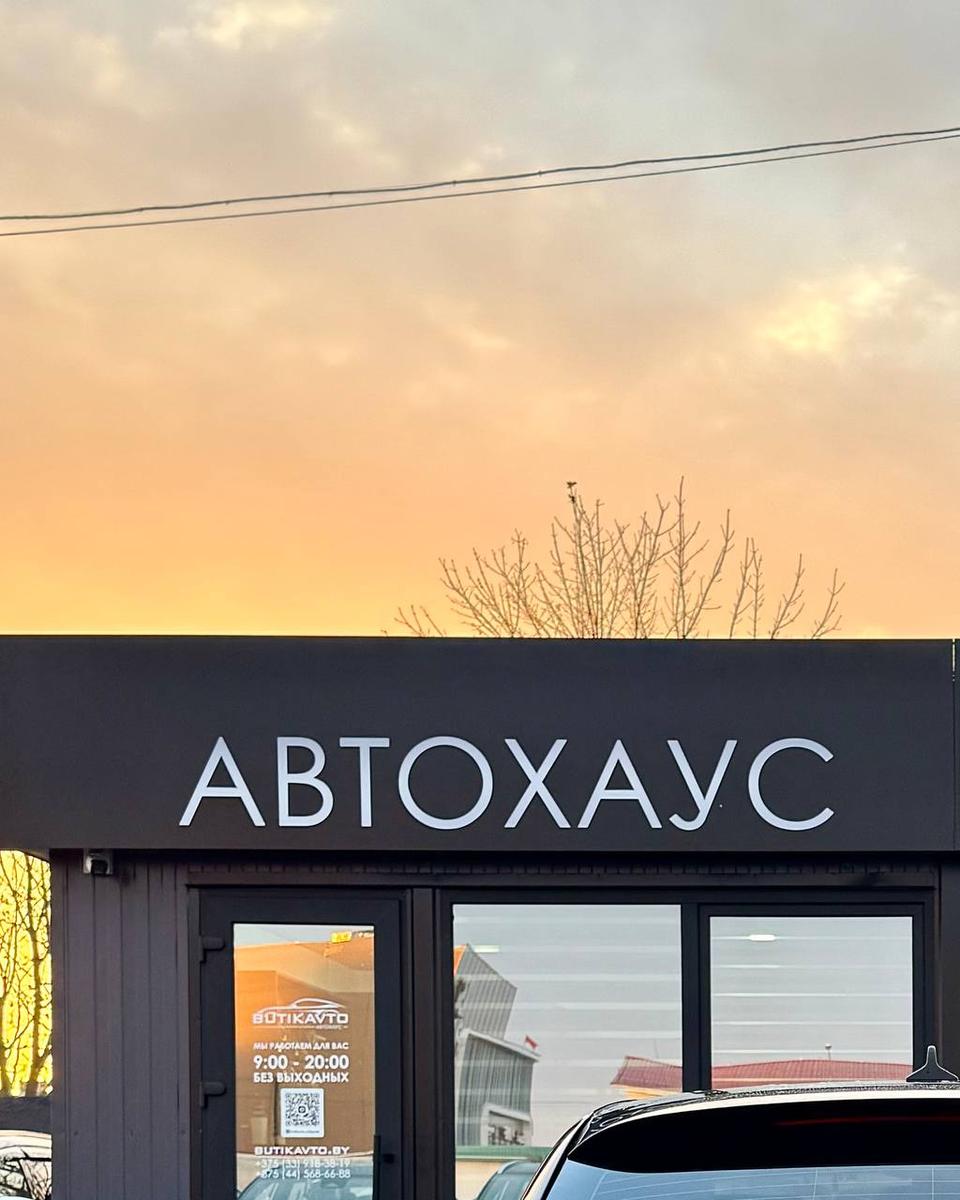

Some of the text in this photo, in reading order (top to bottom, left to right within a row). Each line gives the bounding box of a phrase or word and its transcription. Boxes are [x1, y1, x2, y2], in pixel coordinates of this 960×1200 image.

[179, 736, 834, 831] АВТОХАУС
[252, 1013, 349, 1024] BUTIKAVTO
[253, 1042, 349, 1051] МЫ РАБОТАЕМ ДЛЯ ВАС
[254, 1055, 288, 1069] 9:00
[304, 1055, 350, 1069] 20:00
[254, 1072, 350, 1084] БЕЗ ВЫХОДНЫХ
[254, 1146, 350, 1155] BUTIKAVTO.BY
[303, 1169, 351, 1178] 568-66-88
